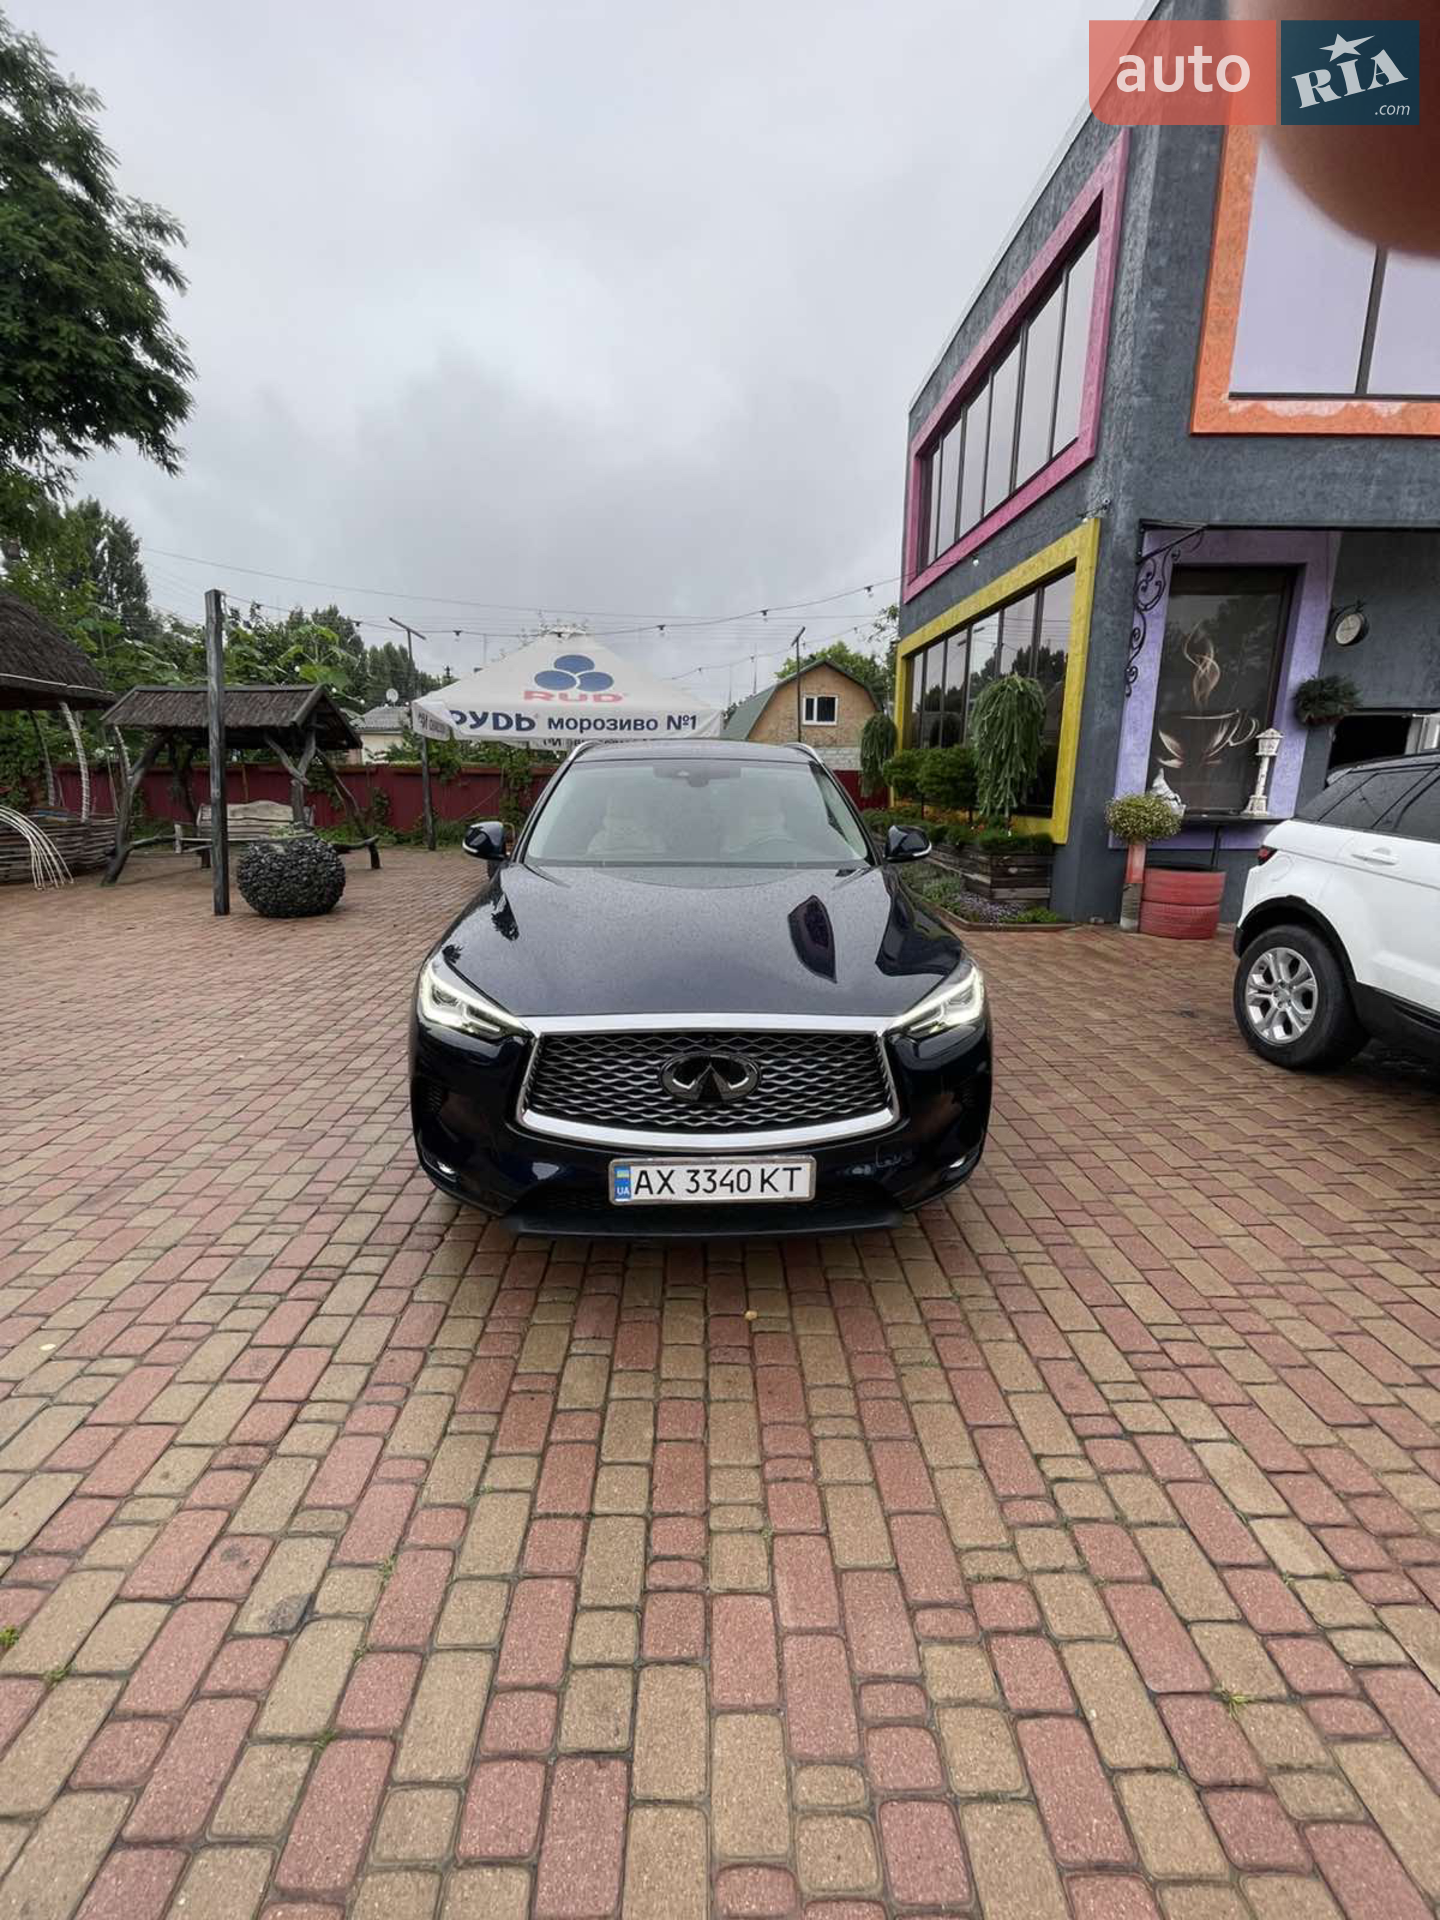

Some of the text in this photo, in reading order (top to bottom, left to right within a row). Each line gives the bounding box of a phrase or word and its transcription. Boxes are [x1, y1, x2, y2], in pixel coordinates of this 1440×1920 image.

[523, 690, 623, 703] RUD
[547, 716, 659, 734] морозиво
[666, 714, 697, 731] №1
[634, 1167, 802, 1195] AX 3340 KT
[616, 1186, 631, 1196] UA
